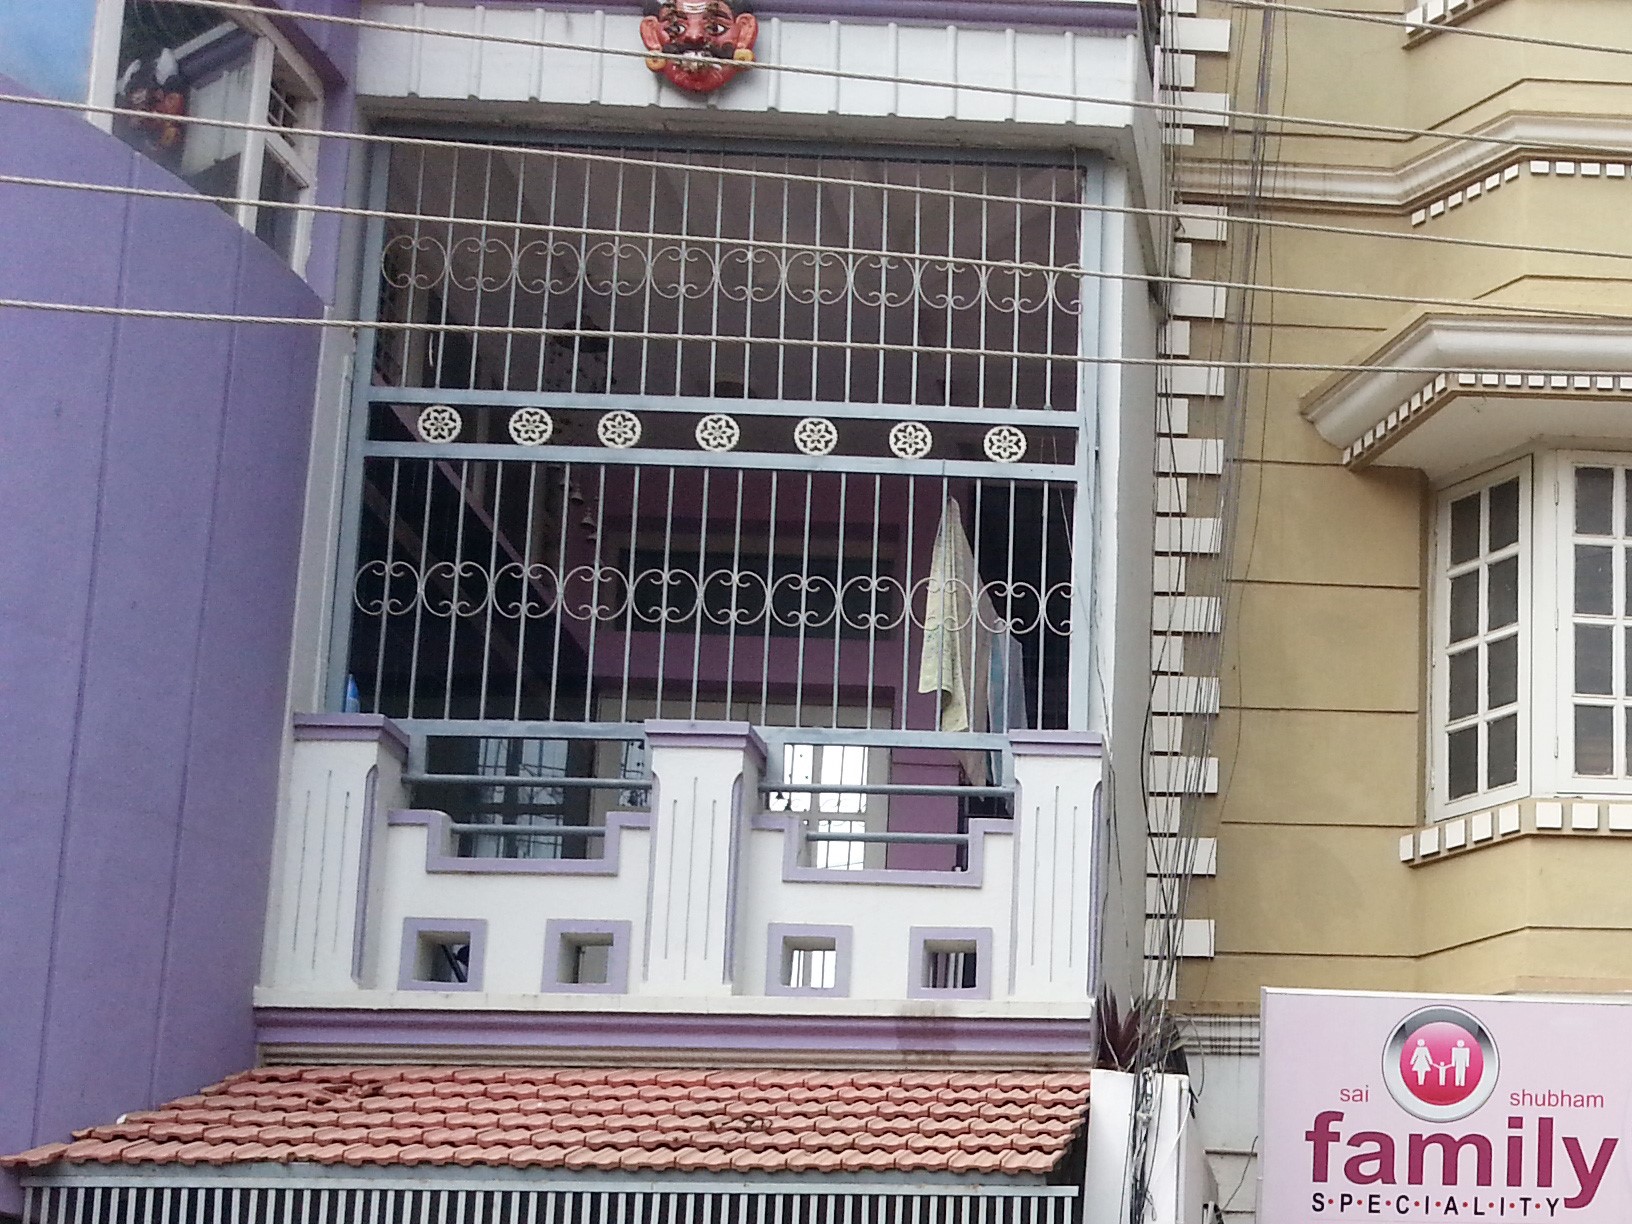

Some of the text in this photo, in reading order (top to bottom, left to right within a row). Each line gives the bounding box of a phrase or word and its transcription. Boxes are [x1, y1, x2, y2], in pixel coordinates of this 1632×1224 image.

[1339, 1084, 1605, 1108] sai shubham
[1304, 1110, 1619, 1209] family
